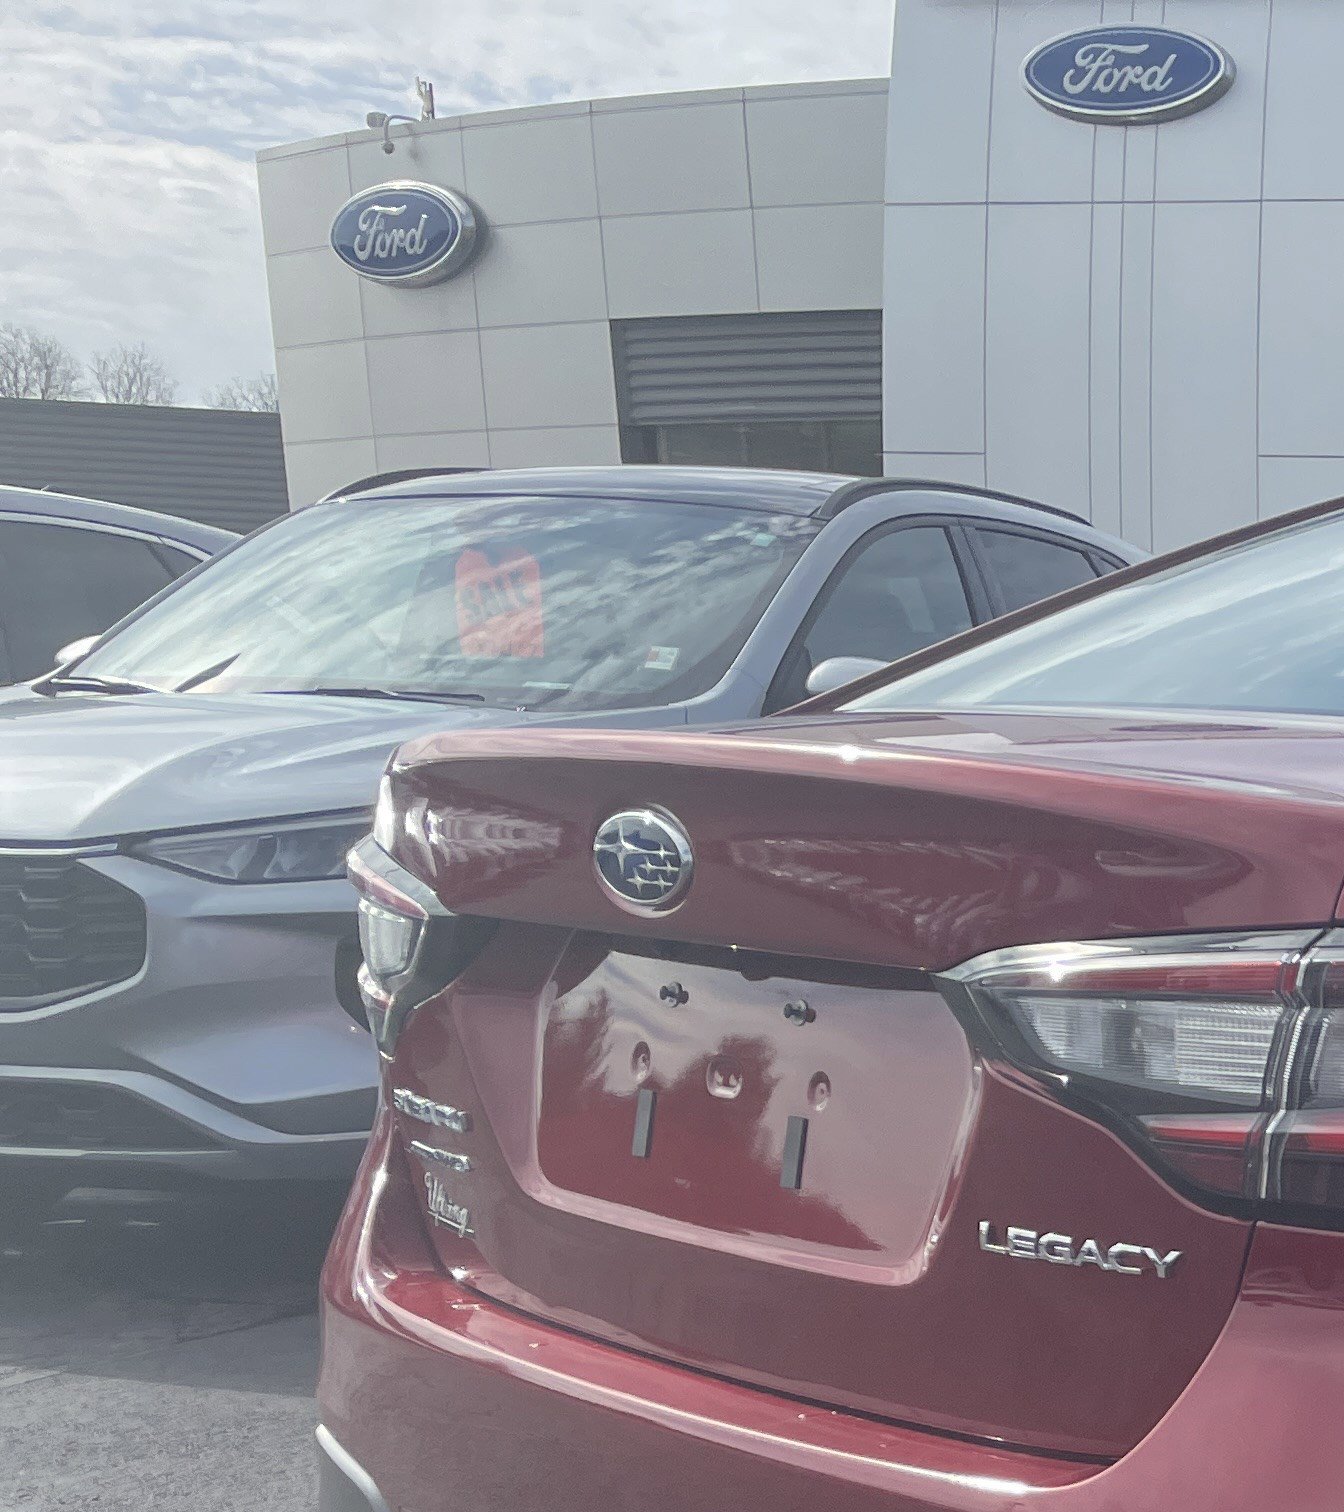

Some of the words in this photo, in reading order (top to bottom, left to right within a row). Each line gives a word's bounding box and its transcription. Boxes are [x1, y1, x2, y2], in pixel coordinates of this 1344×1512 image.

[1062, 43, 1178, 94] Ford
[353, 204, 429, 261] Ford
[979, 1220, 1182, 1278] LEGACY
